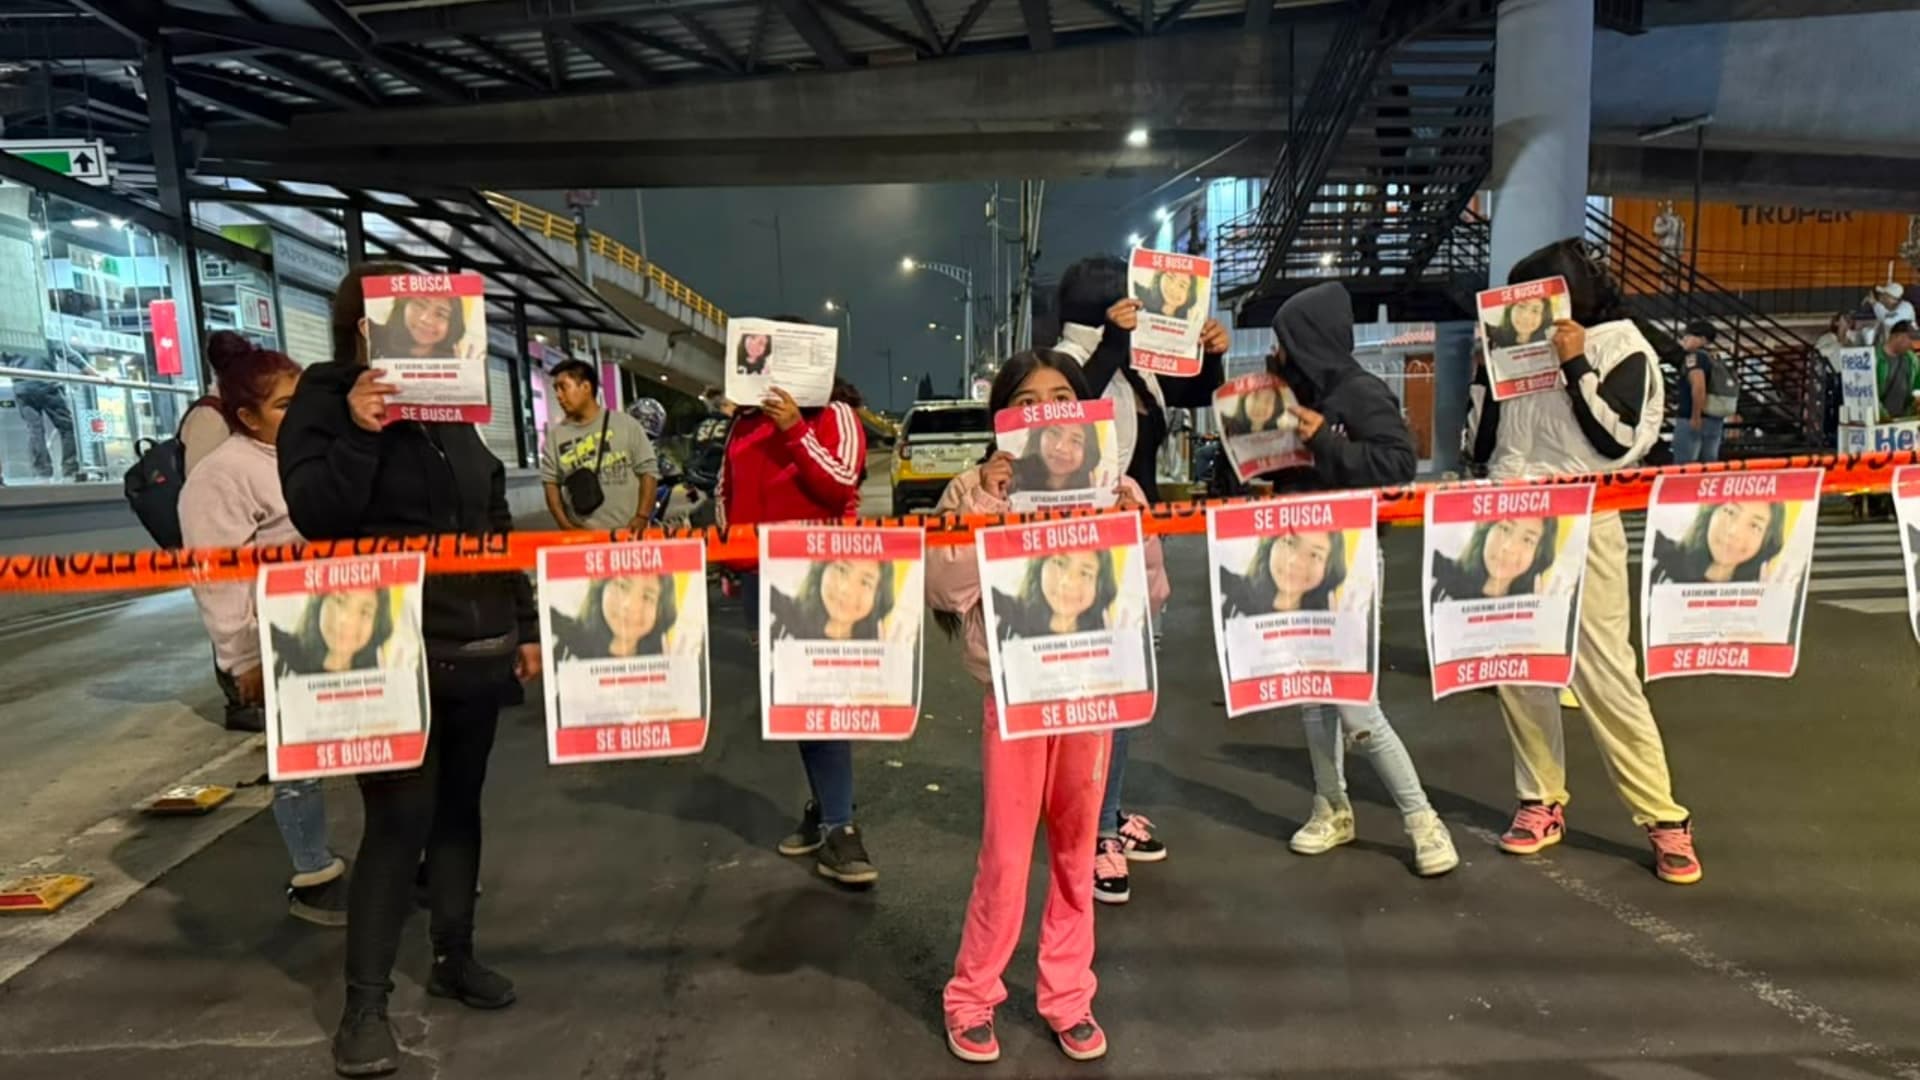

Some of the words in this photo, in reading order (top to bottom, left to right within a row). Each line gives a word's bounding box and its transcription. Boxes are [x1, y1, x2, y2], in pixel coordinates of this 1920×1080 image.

[1735, 203, 1855, 225] TRUPER
[390, 276, 406, 292] SE
[409, 275, 452, 292] BUSCA
[1501, 290, 1513, 301] SE
[1514, 284, 1544, 298] BUSCA
[401, 407, 417, 420] SE
[420, 407, 463, 422] BUSCA
[1023, 406, 1040, 422] SE
[1044, 401, 1084, 420] BUSCA
[1697, 478, 1718, 497] SE
[1722, 475, 1777, 496] BUSCA
[1472, 495, 1493, 515] SE
[1497, 491, 1550, 513] BUSCA
[1254, 509, 1274, 529] SE
[1279, 504, 1333, 527] BUSCA
[806, 533, 826, 553] SE
[831, 533, 883, 554] BUSCA
[1022, 529, 1041, 551] SE
[1047, 523, 1099, 548] BUSCA
[585, 550, 604, 572] SE
[610, 547, 663, 571] BUSCA
[305, 565, 323, 588] SE
[328, 562, 381, 586] BUSCA
[1672, 649, 1692, 669] SE
[1696, 647, 1749, 667] BUSCA
[1457, 664, 1475, 683] SE
[1479, 659, 1529, 680] BUSCA
[1259, 681, 1277, 701] SE
[1282, 676, 1333, 697] BUSCA
[805, 710, 825, 731] SE
[830, 710, 880, 731] BUSCA
[1041, 706, 1062, 727] SE
[1066, 699, 1119, 724] BUSCA
[596, 730, 614, 751] SE
[621, 725, 671, 749] BUSCA
[316, 745, 336, 768] SE
[341, 739, 393, 765] BUSCA
